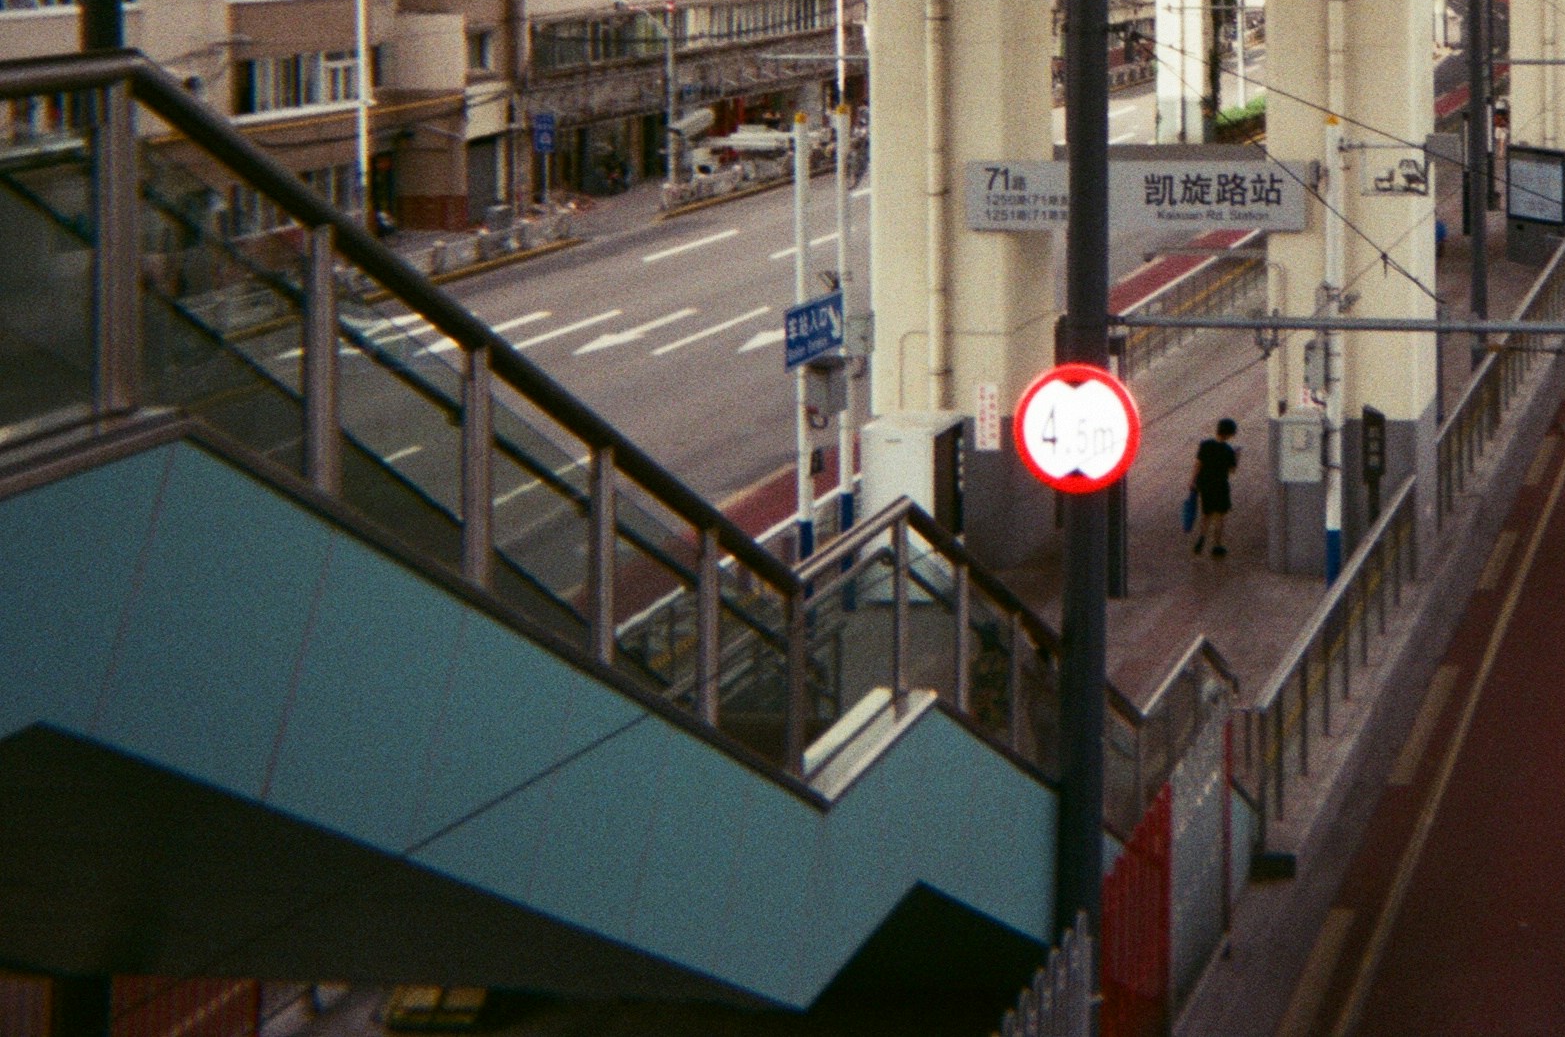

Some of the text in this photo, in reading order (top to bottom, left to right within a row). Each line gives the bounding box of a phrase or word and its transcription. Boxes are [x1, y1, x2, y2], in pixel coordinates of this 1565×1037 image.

[984, 167, 1026, 191] 71路
[1144, 173, 1283, 206] 凯旋路站
